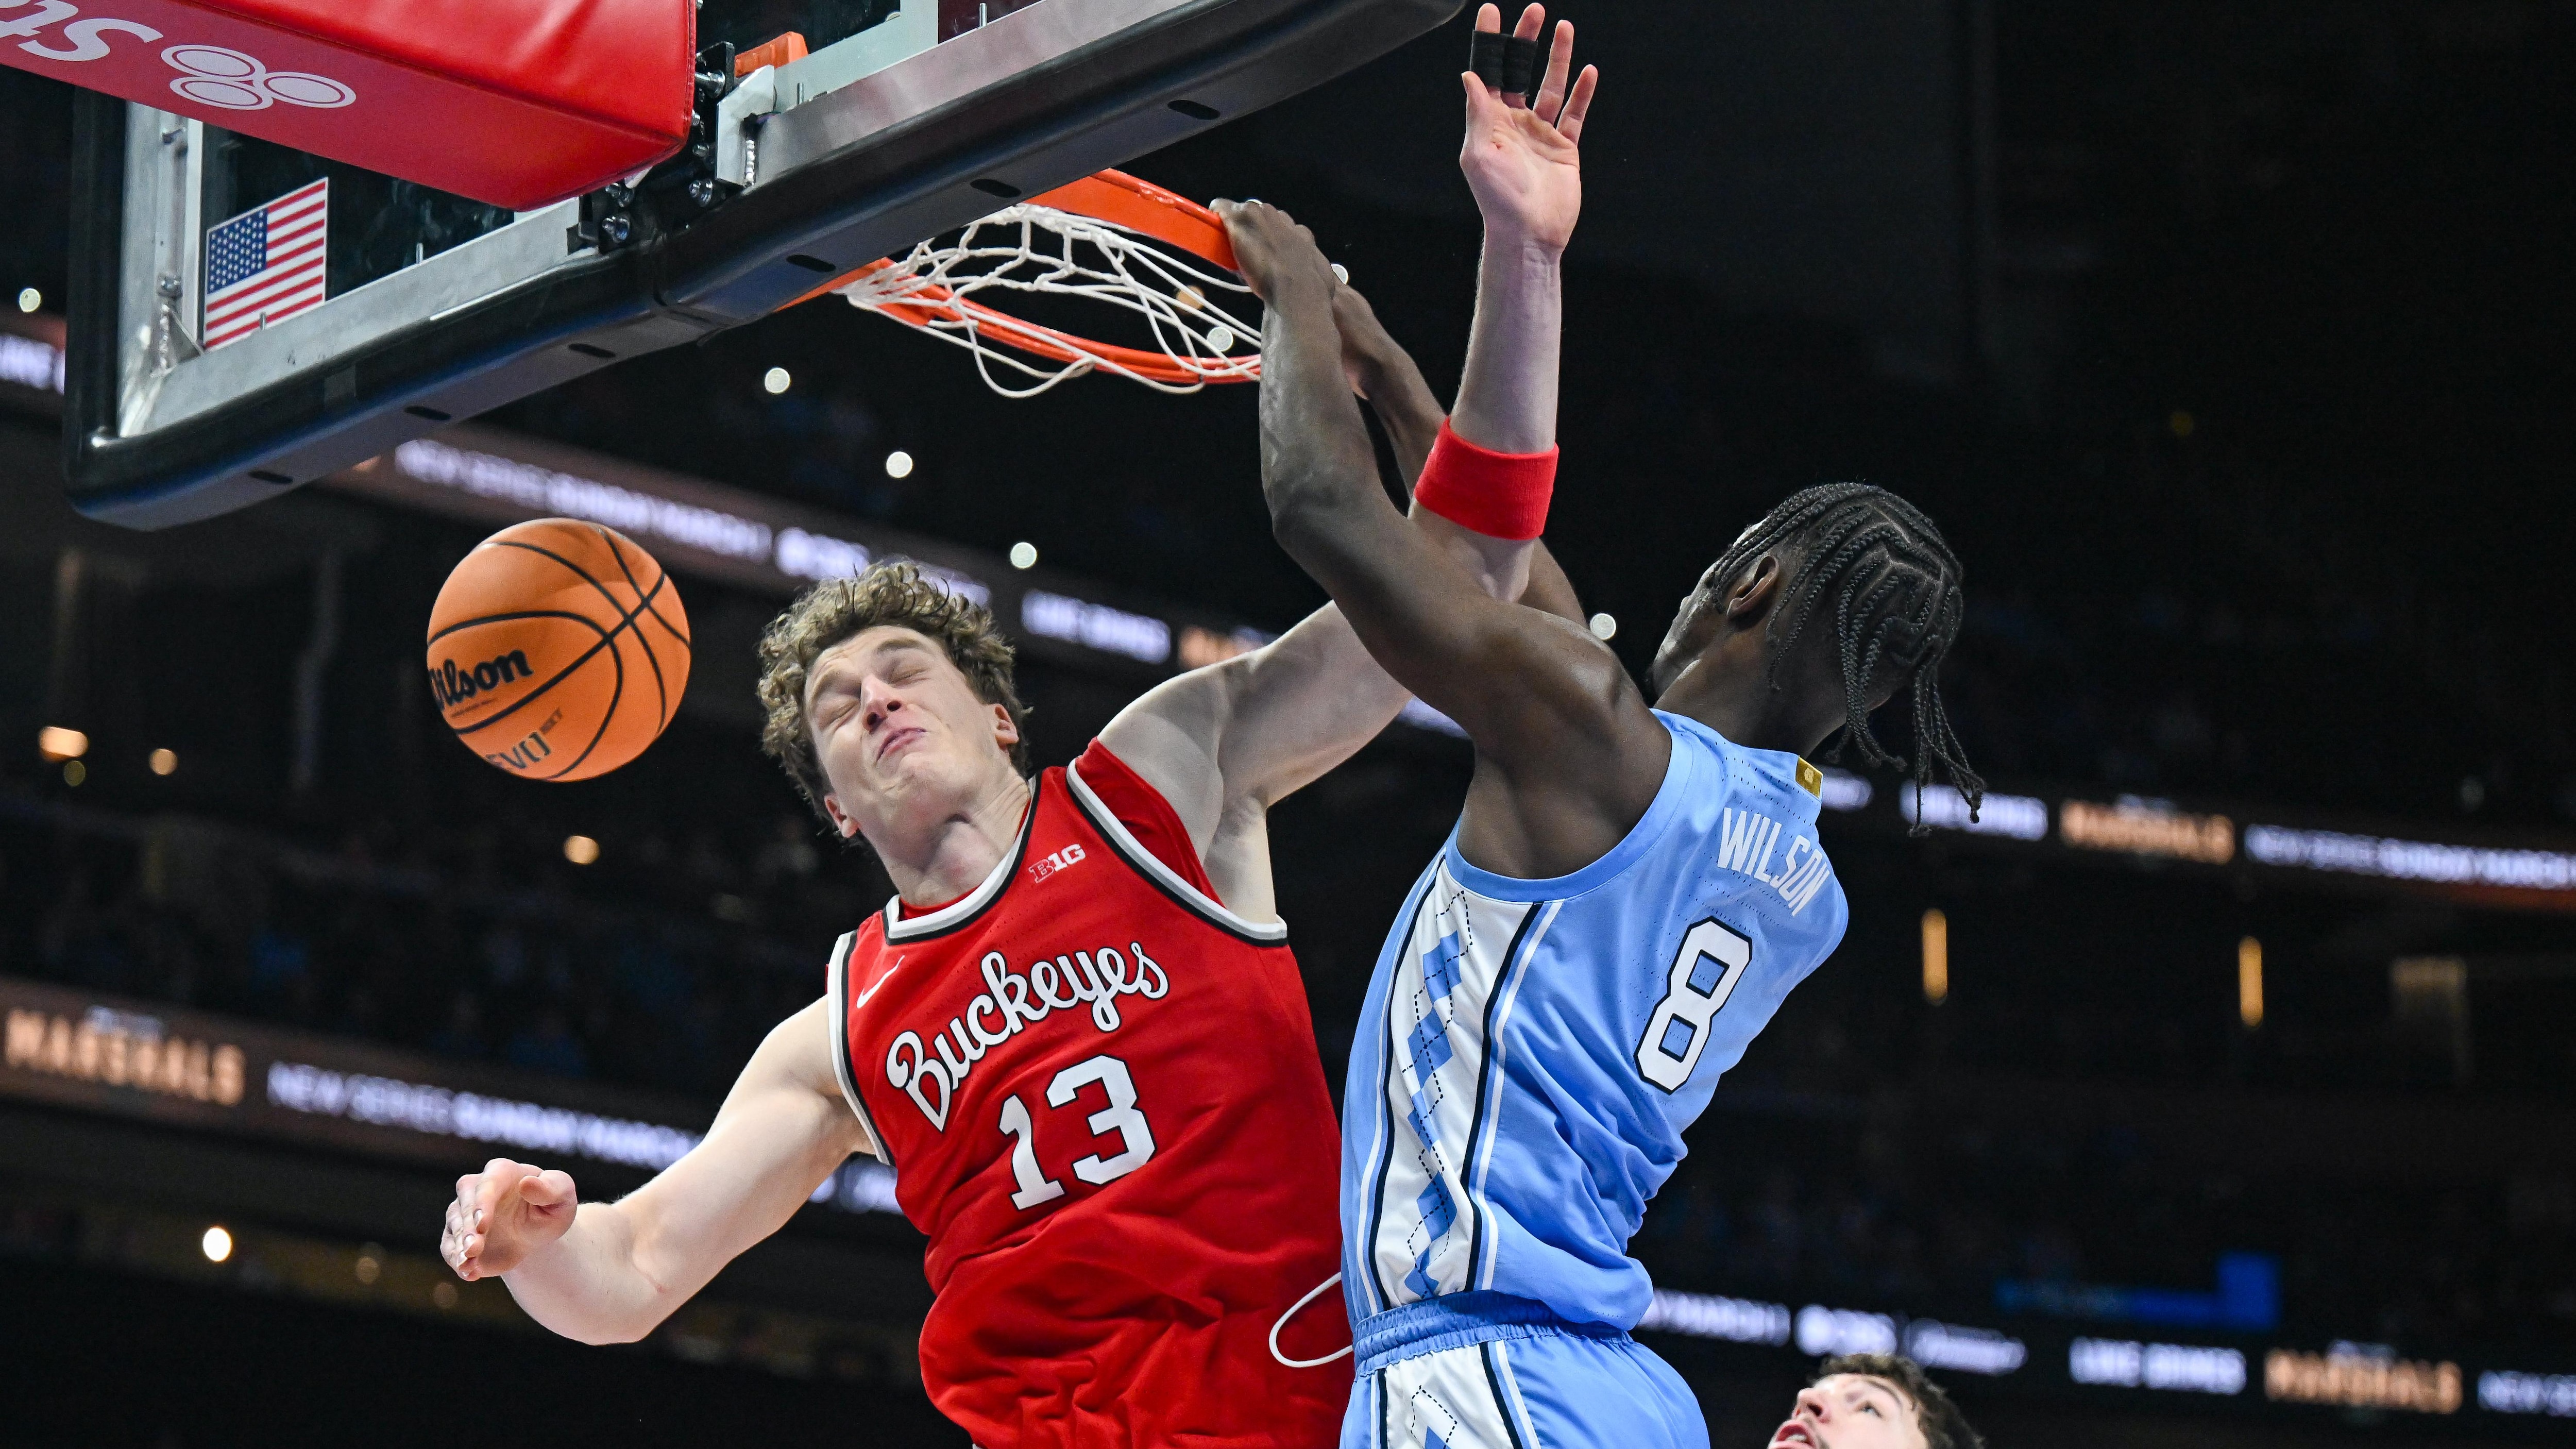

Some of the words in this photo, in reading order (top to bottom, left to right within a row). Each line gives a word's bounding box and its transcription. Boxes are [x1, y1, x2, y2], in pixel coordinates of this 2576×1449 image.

[1717, 807, 1830, 917] WILSON
[886, 941, 1169, 1133] Buckeyes
[1634, 916, 1752, 1095] 8
[998, 1054, 1157, 1211] 13
